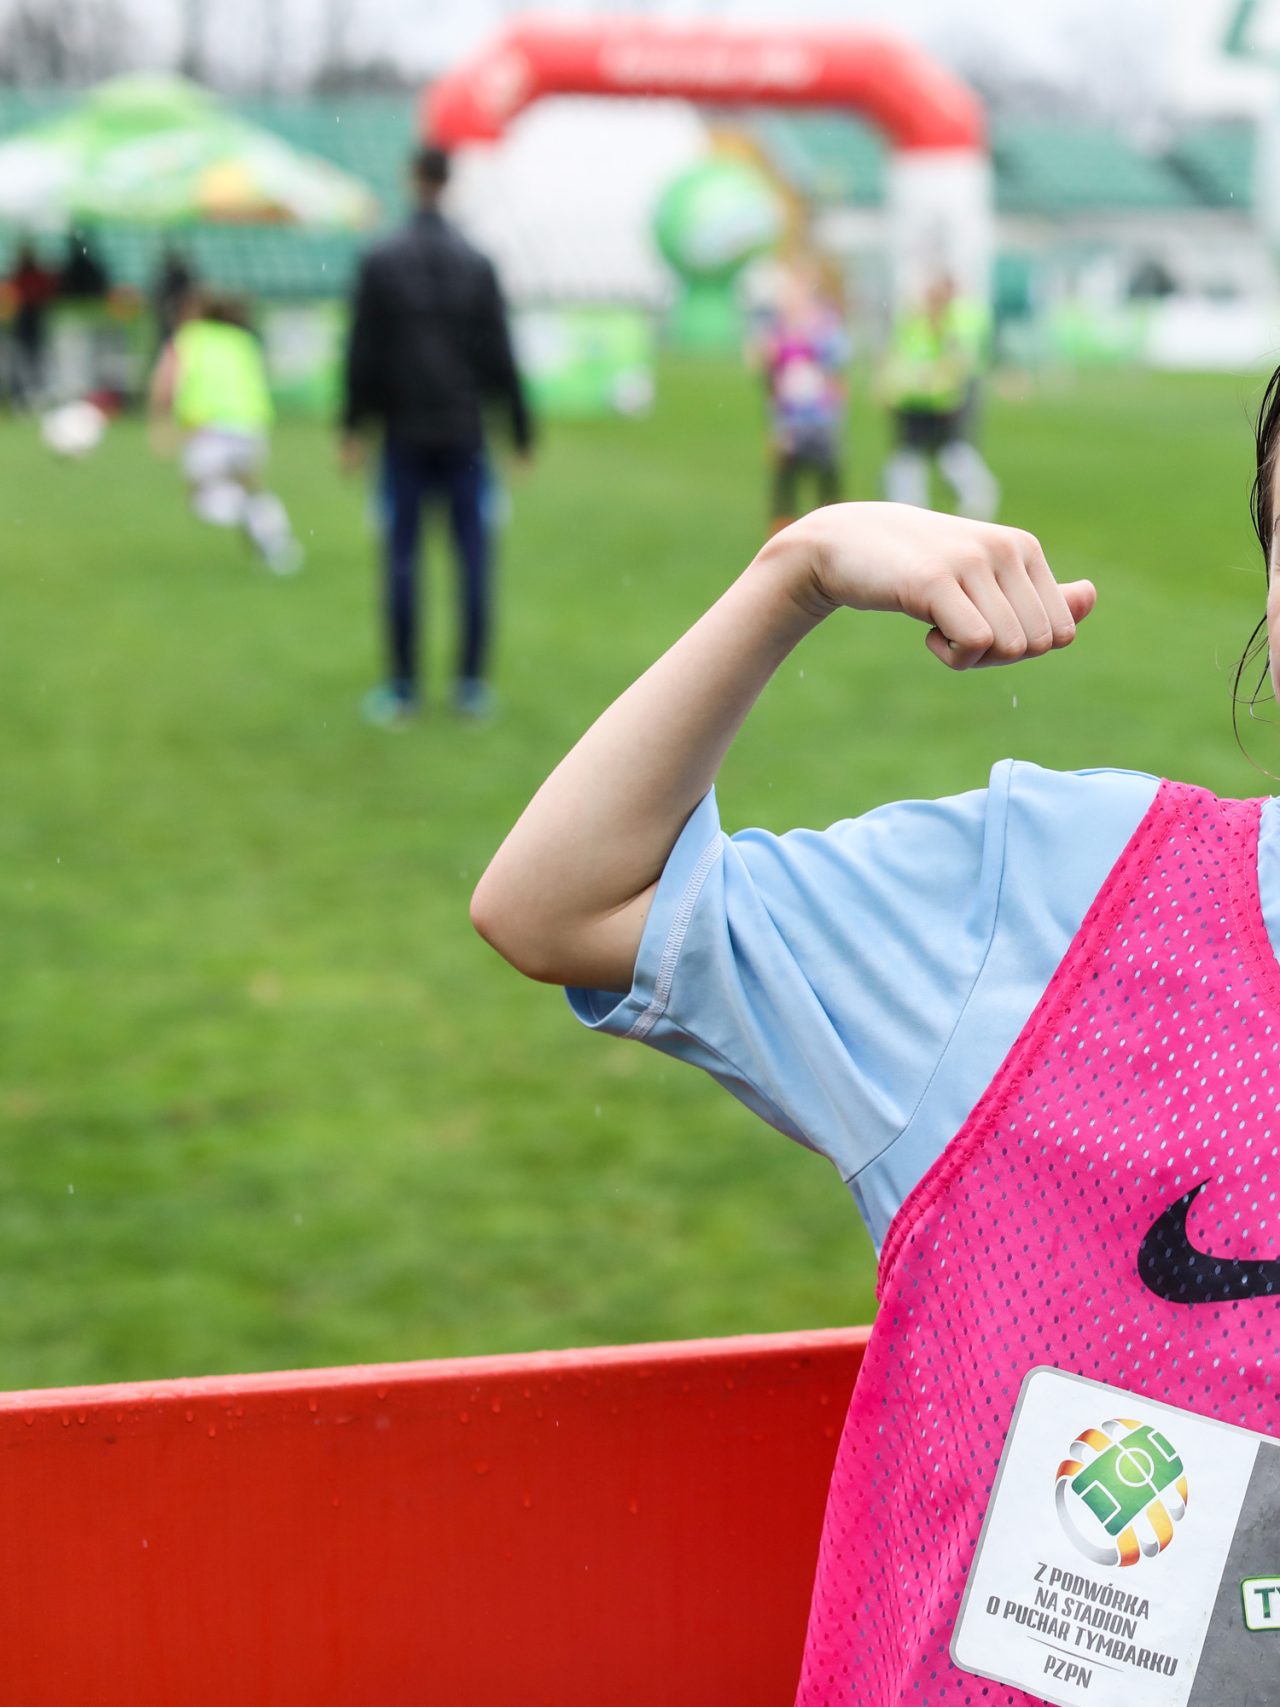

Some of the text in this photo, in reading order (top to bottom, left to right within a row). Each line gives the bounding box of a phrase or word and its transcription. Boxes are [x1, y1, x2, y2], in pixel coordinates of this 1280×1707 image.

[1034, 1562, 1149, 1620] Z PODWÓRKA
[1034, 1586, 1138, 1640] NA STADION
[986, 1595, 1179, 1677] O PUCHAR TYMBARKU
[1043, 1654, 1093, 1689] PZPN
